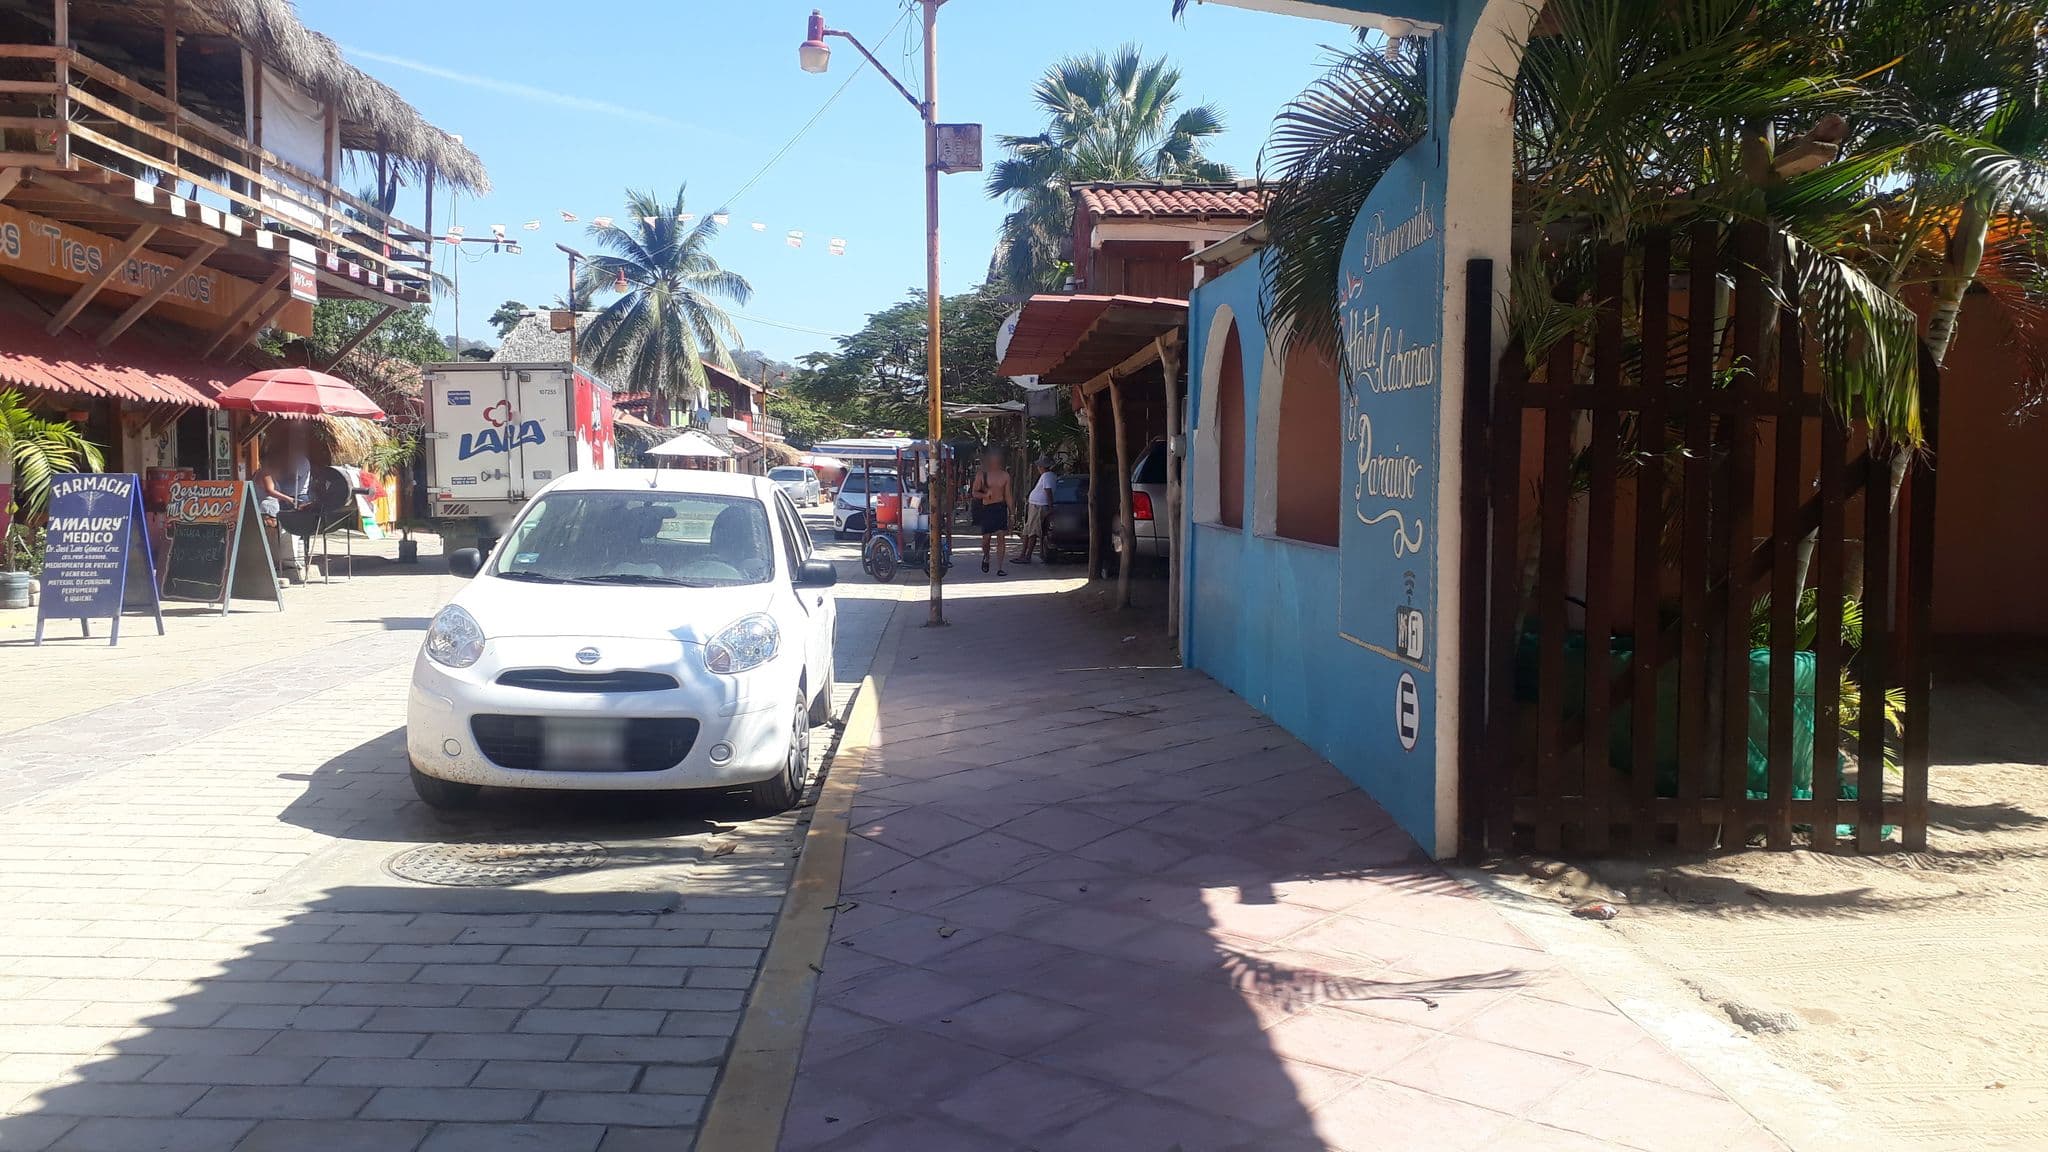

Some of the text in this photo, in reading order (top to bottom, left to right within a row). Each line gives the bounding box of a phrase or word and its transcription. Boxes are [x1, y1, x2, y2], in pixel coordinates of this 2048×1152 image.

[1345, 305, 1380, 384] Hotel
[458, 420, 546, 461] LALA
[52, 476, 131, 498] FARMACIA
[170, 482, 234, 501] Restaurant
